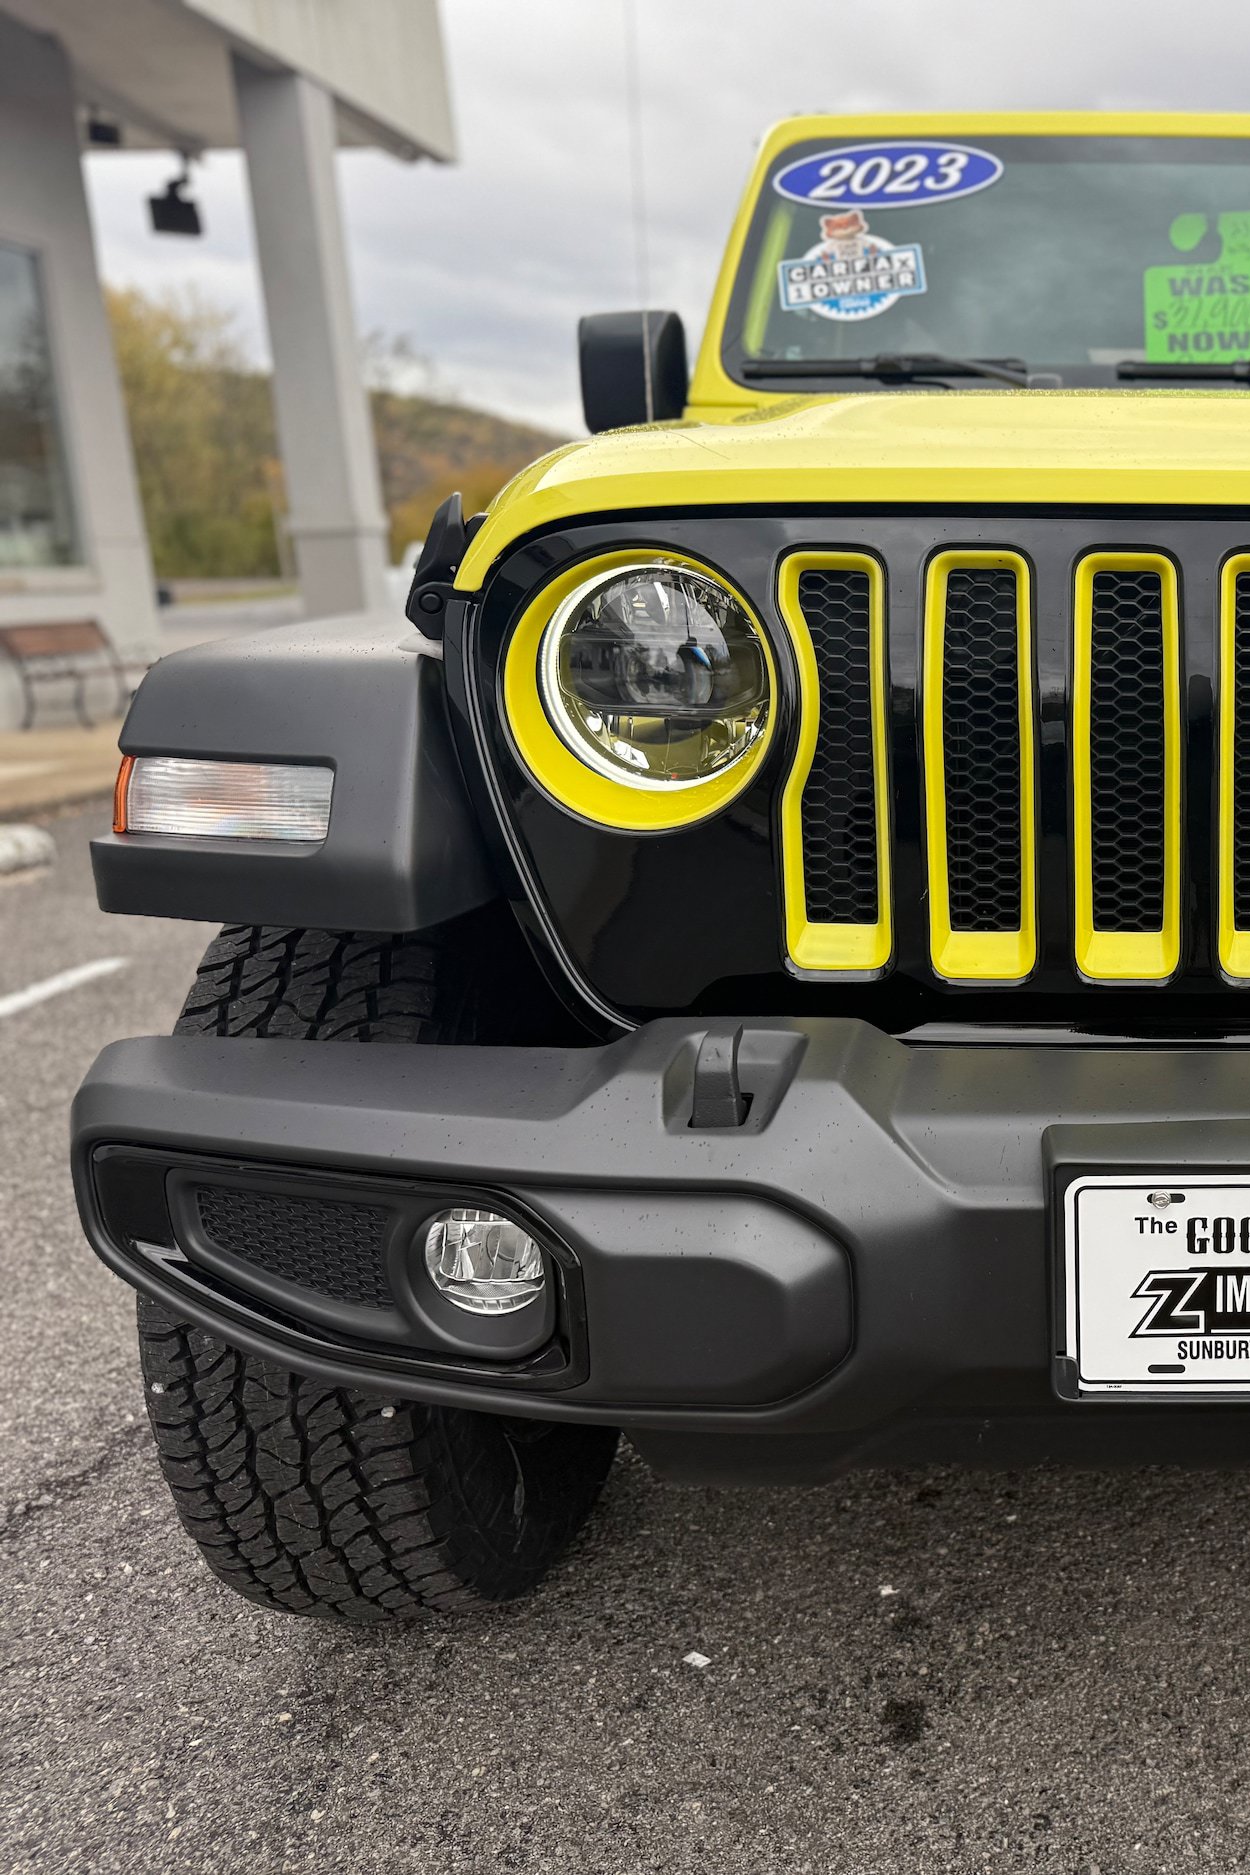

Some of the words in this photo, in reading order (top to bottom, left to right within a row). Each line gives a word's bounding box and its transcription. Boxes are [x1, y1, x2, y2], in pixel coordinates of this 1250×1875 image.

[808, 152, 969, 199] 2023
[789, 256, 911, 282] CARFAX
[793, 287, 804, 300] 1
[813, 272, 915, 298] OWNER
[1135, 1216, 1178, 1234] The
